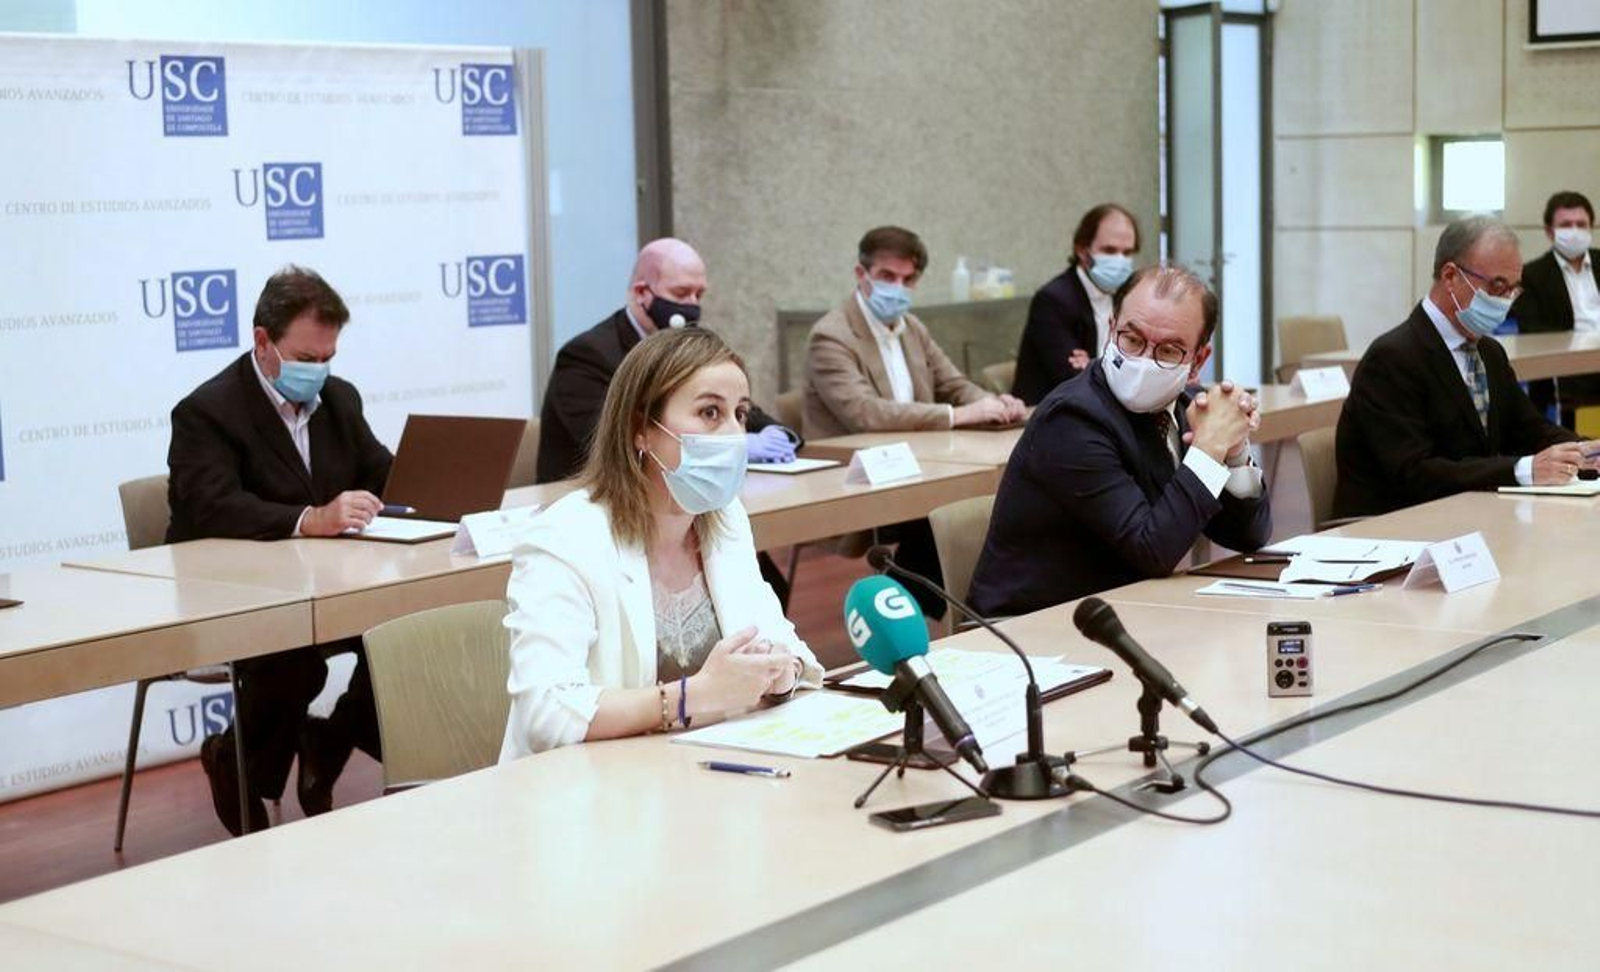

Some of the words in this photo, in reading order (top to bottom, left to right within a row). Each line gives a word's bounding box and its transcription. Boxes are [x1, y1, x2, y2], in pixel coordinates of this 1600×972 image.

[27, 87, 104, 101] AVANZADOS
[125, 60, 219, 102] USC
[433, 67, 509, 106] USC
[6, 199, 57, 215] CENTRO
[81, 199, 139, 213] ESTUDIOS
[142, 197, 212, 212] AVANZADOS
[233, 166, 317, 207] USC
[138, 274, 230, 319] USC
[439, 258, 517, 298] USC
[40, 311, 119, 328] AVANZADOS
[18, 425, 70, 443] CENTRO
[55, 531, 127, 550] AVANZADO
[166, 698, 234, 746] US
